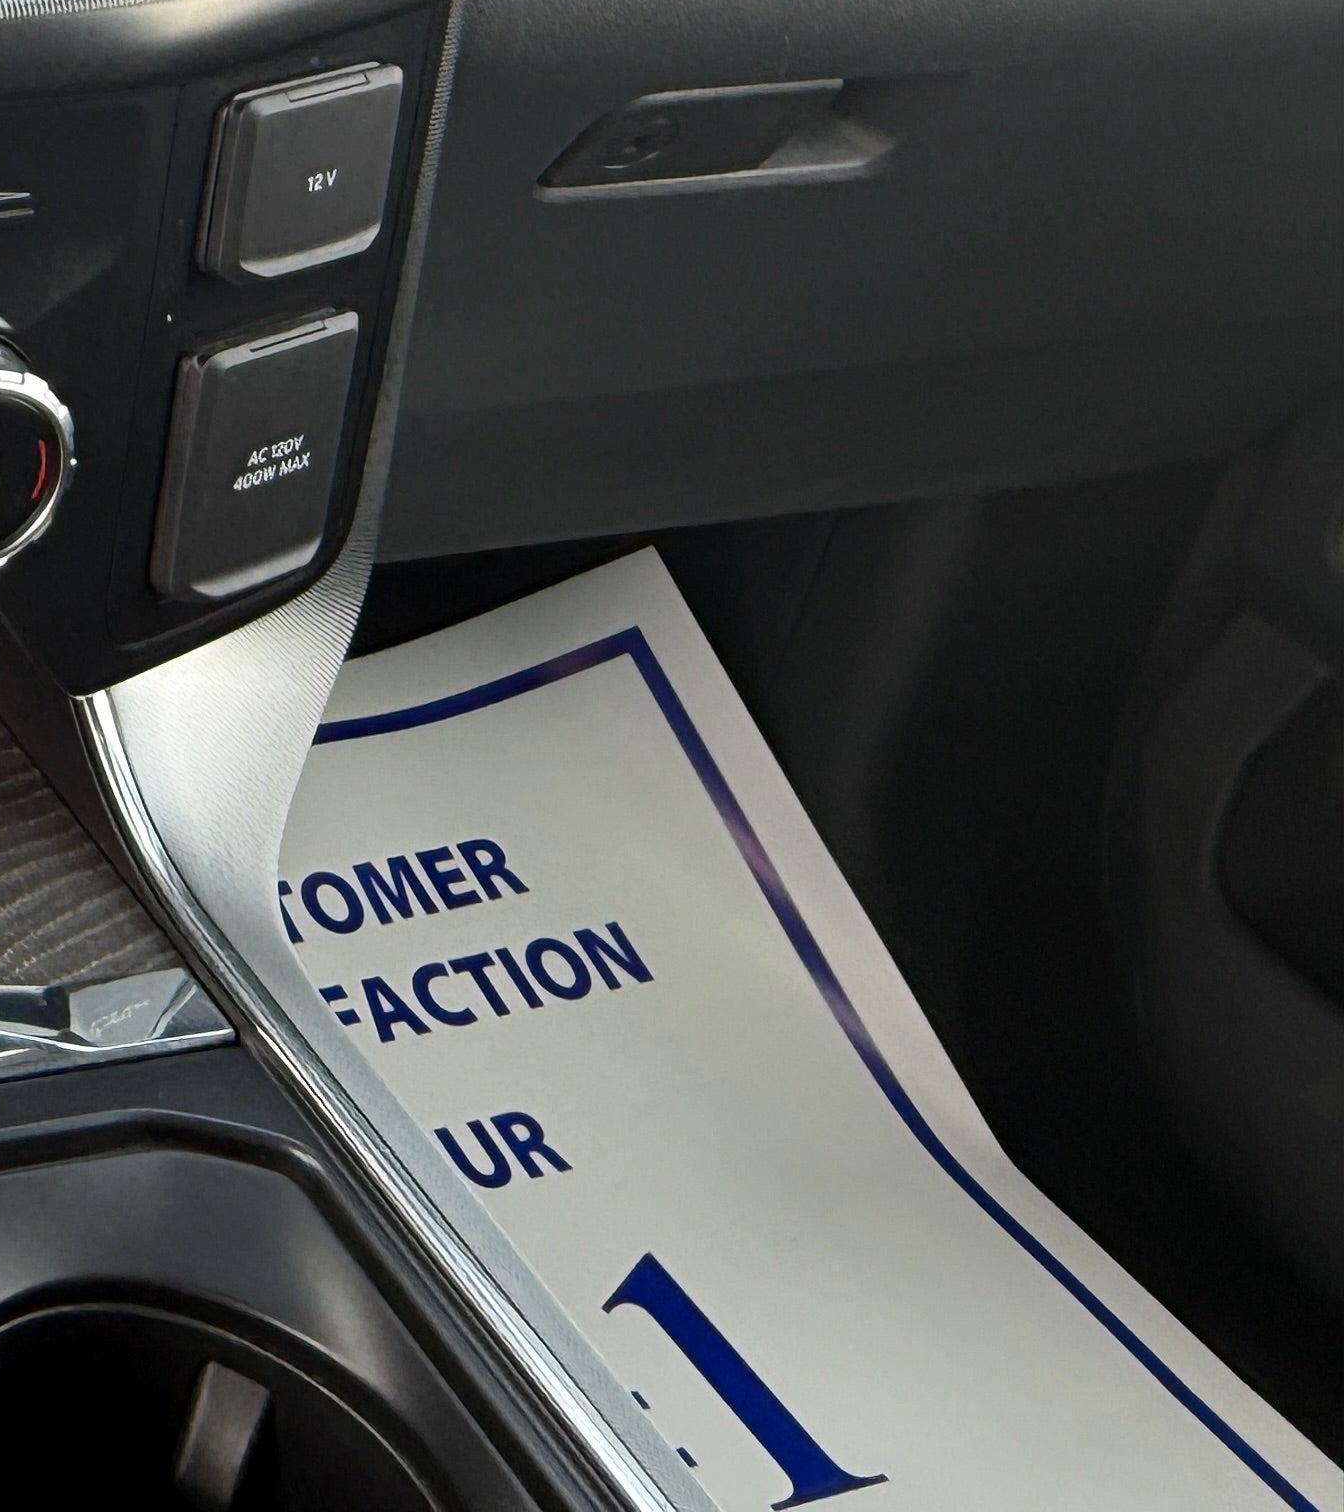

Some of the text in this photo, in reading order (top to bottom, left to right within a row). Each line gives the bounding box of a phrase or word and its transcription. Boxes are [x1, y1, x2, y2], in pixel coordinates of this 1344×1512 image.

[232, 451, 311, 491] 400W MAX
[247, 446, 268, 467] AC
